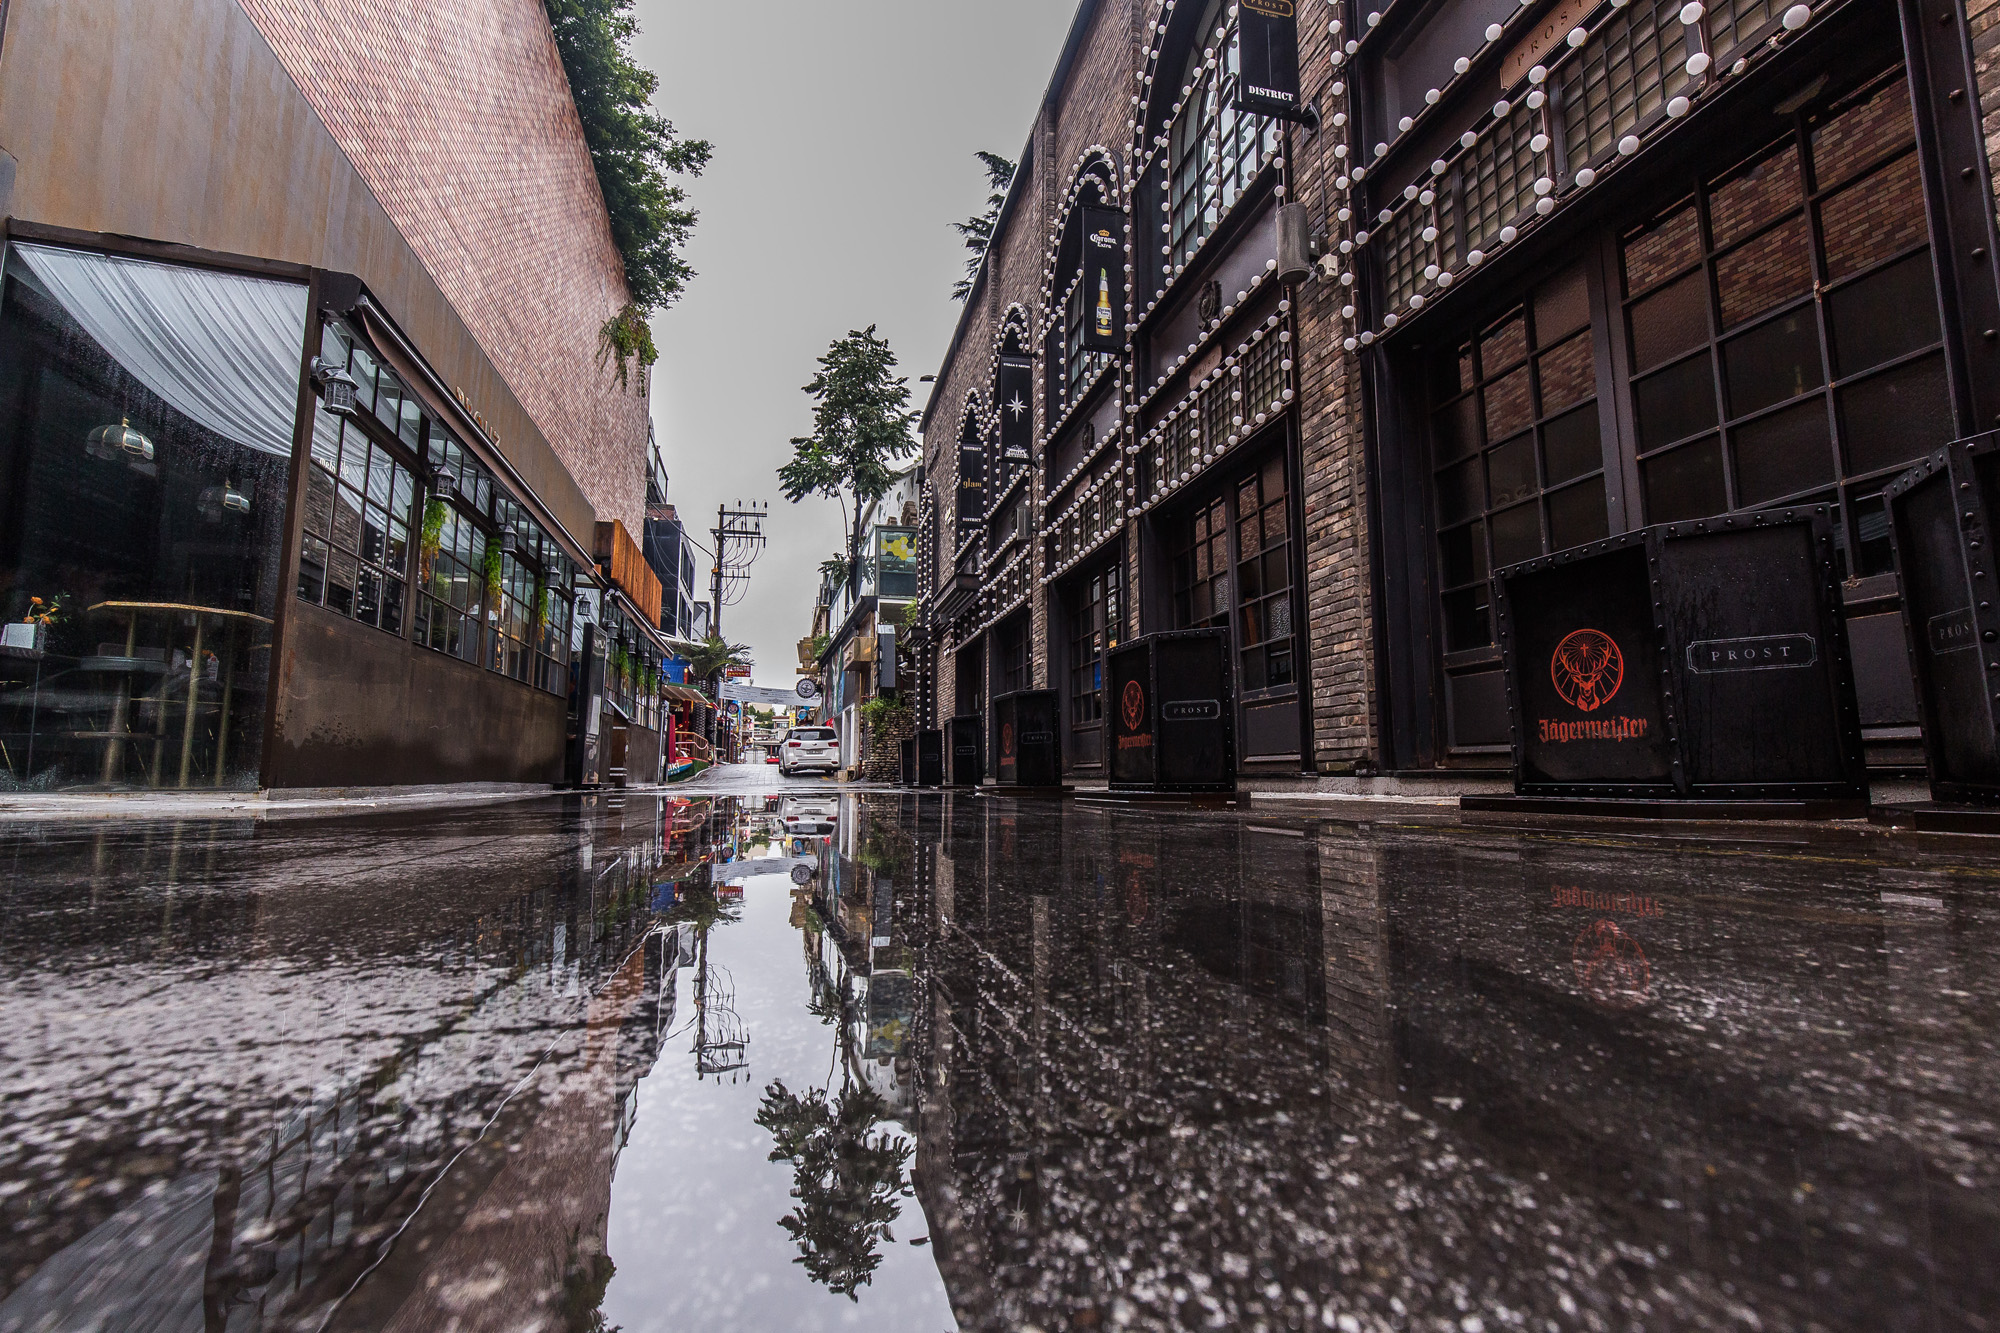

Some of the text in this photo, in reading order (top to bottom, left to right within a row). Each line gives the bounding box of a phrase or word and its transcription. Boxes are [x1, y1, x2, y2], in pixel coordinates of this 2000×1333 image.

[1248, 85, 1294, 101] DISTRICT
[1090, 233, 1117, 245] Corona
[962, 477, 982, 489] glam
[1939, 620, 1973, 641] PROS
[1711, 645, 1791, 662] PROST
[1173, 706, 1209, 715] PROST
